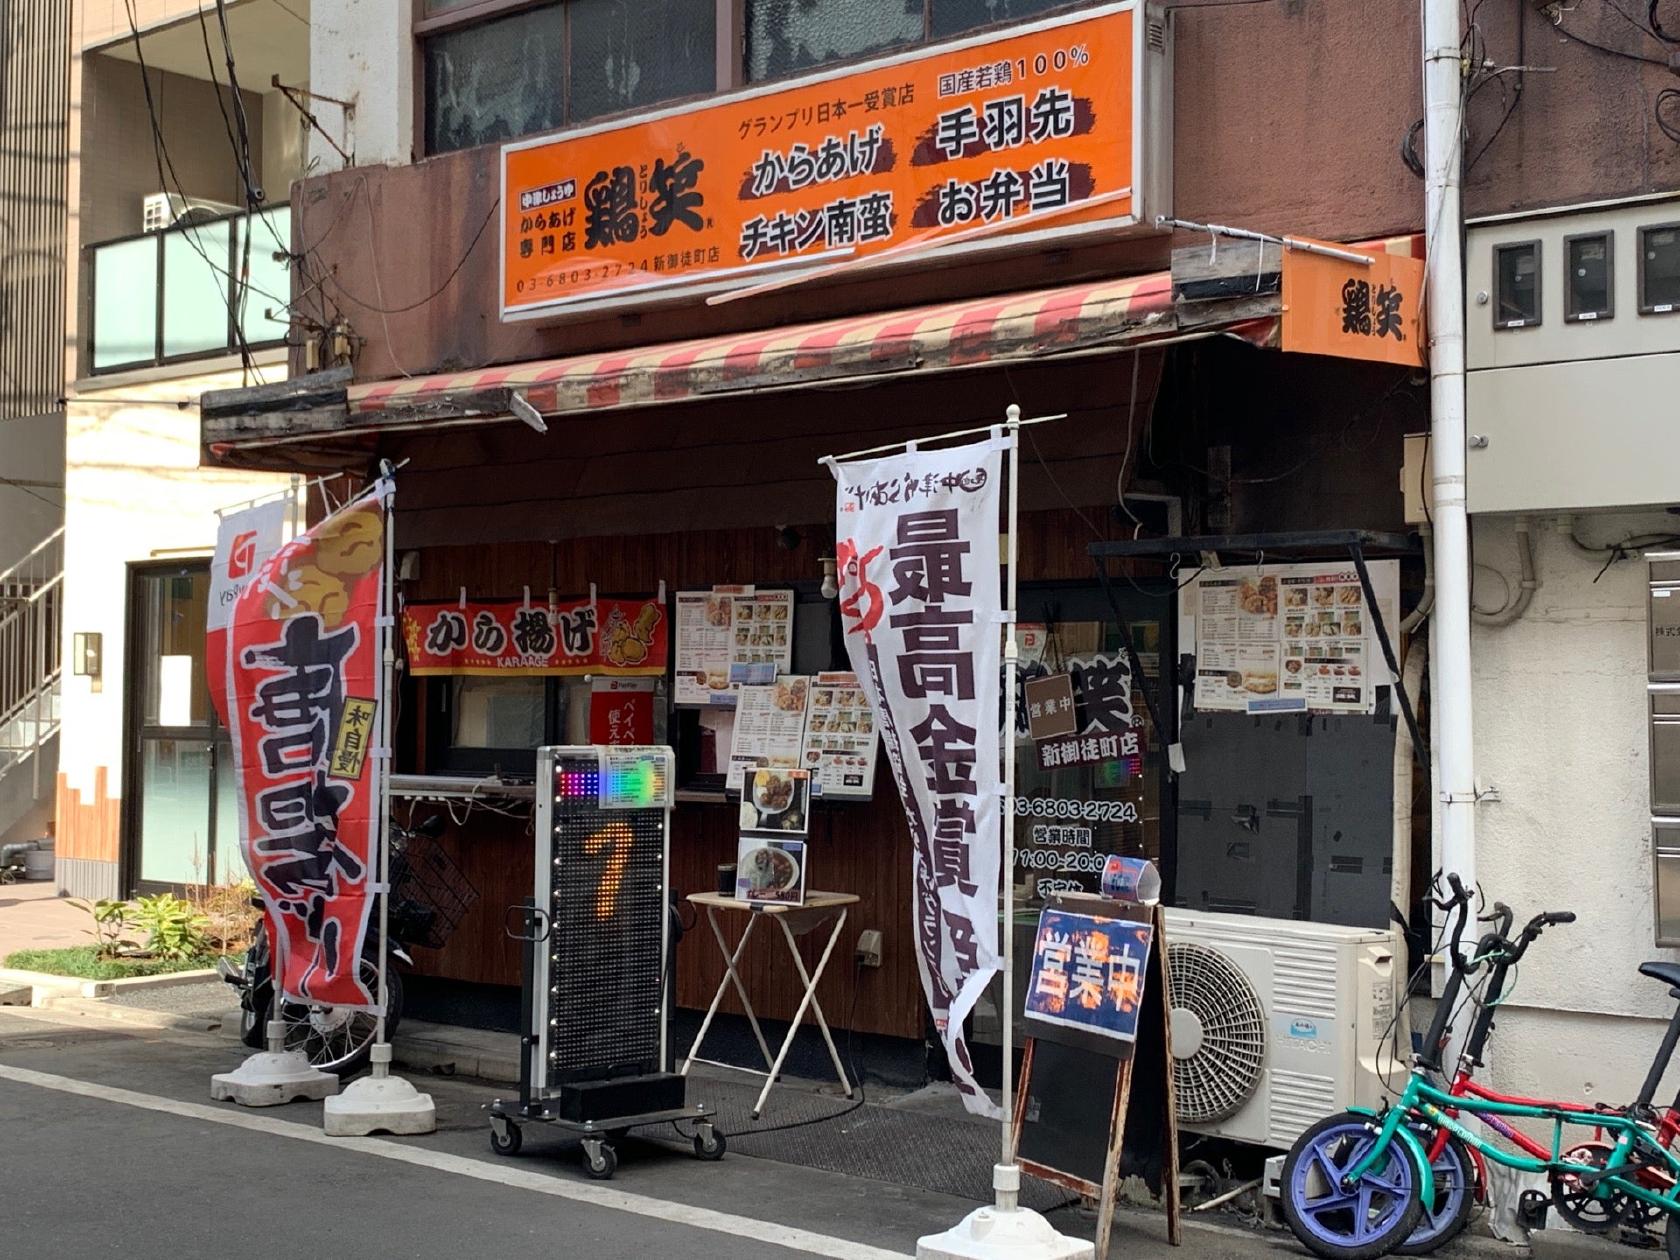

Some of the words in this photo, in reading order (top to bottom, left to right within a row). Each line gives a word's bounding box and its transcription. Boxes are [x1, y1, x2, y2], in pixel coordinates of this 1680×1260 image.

[738, 83, 915, 140] グランプリ日本一受賞店
[937, 87, 1074, 160] 手羽先
[753, 122, 884, 196] からあげ
[938, 159, 1070, 226] お弁当
[520, 206, 577, 234] からあげ
[740, 191, 893, 260] チキン南蛮
[520, 231, 576, 258] 専門店
[653, 246, 720, 272] 新御徒町店
[427, 606, 598, 657] から揚げ
[496, 656, 549, 669] KARAAGE
[623, 698, 636, 745] ペイペ
[1030, 696, 1072, 719] 営業中
[1041, 731, 1139, 767] 新御徒町店
[1013, 798, 1137, 823] 3-6803-2724
[1033, 824, 1092, 847] 営業時間
[1035, 930, 1141, 1012] 営業中
